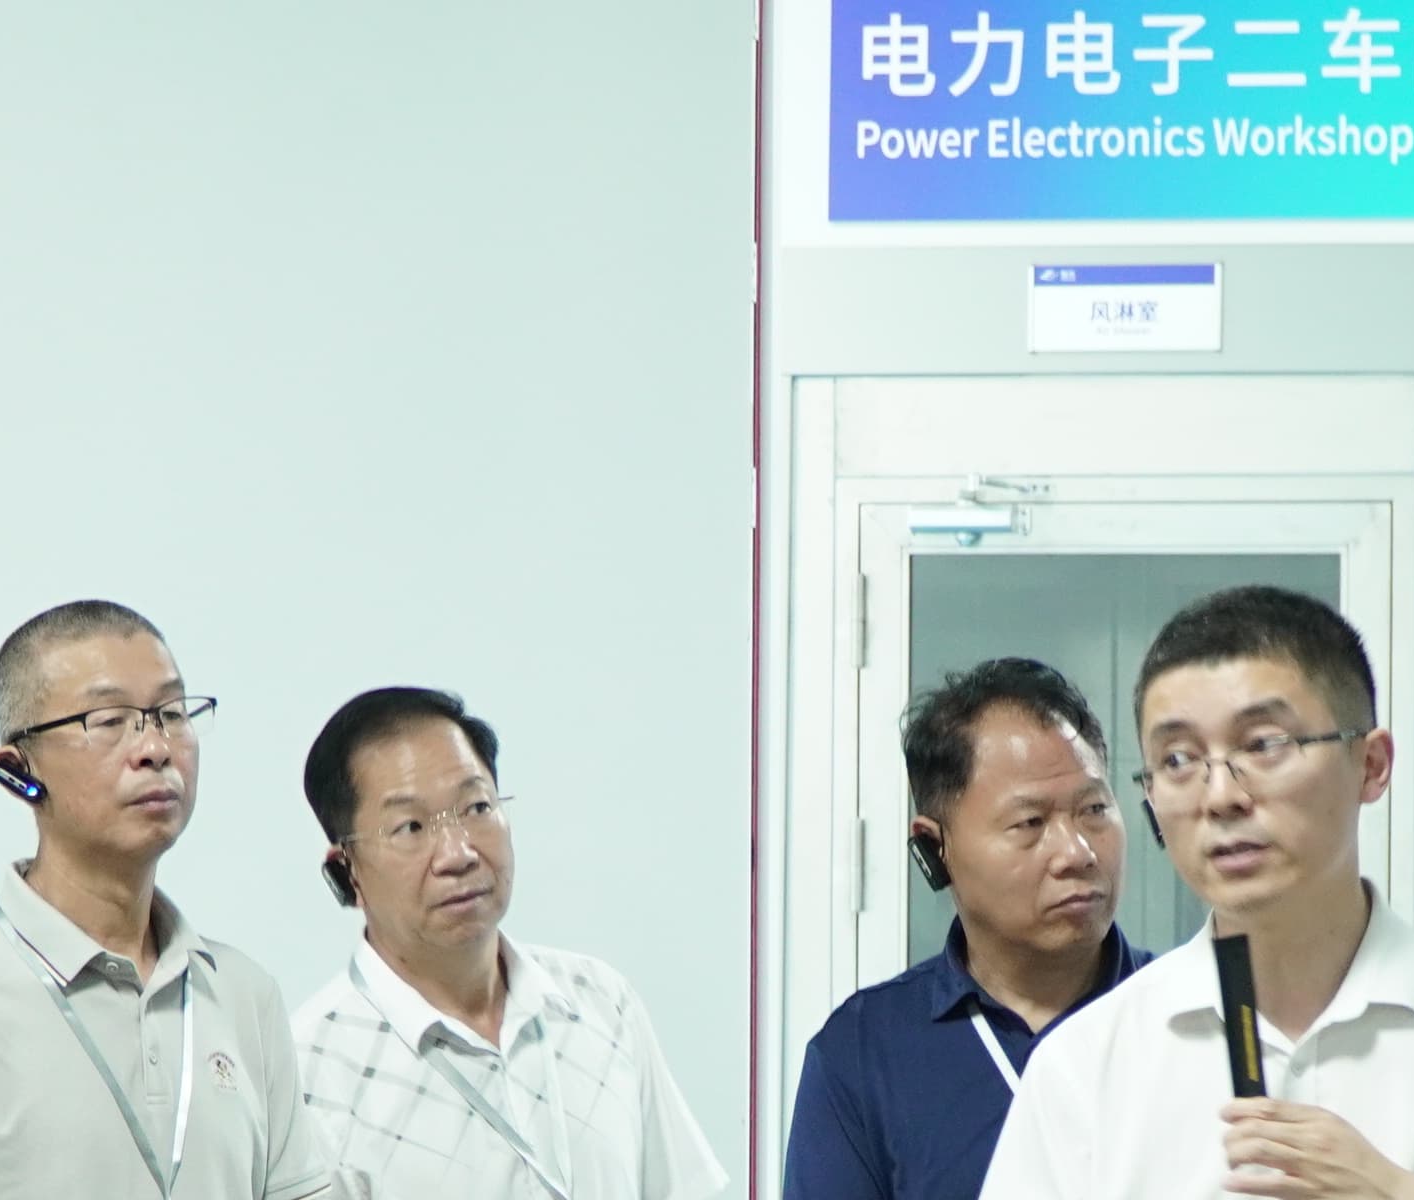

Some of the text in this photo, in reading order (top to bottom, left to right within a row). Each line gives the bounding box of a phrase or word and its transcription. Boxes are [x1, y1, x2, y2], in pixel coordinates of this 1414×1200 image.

[855, 119, 981, 160] Power
[986, 116, 1206, 159] Electronics
[1211, 115, 1414, 165] Workshop
